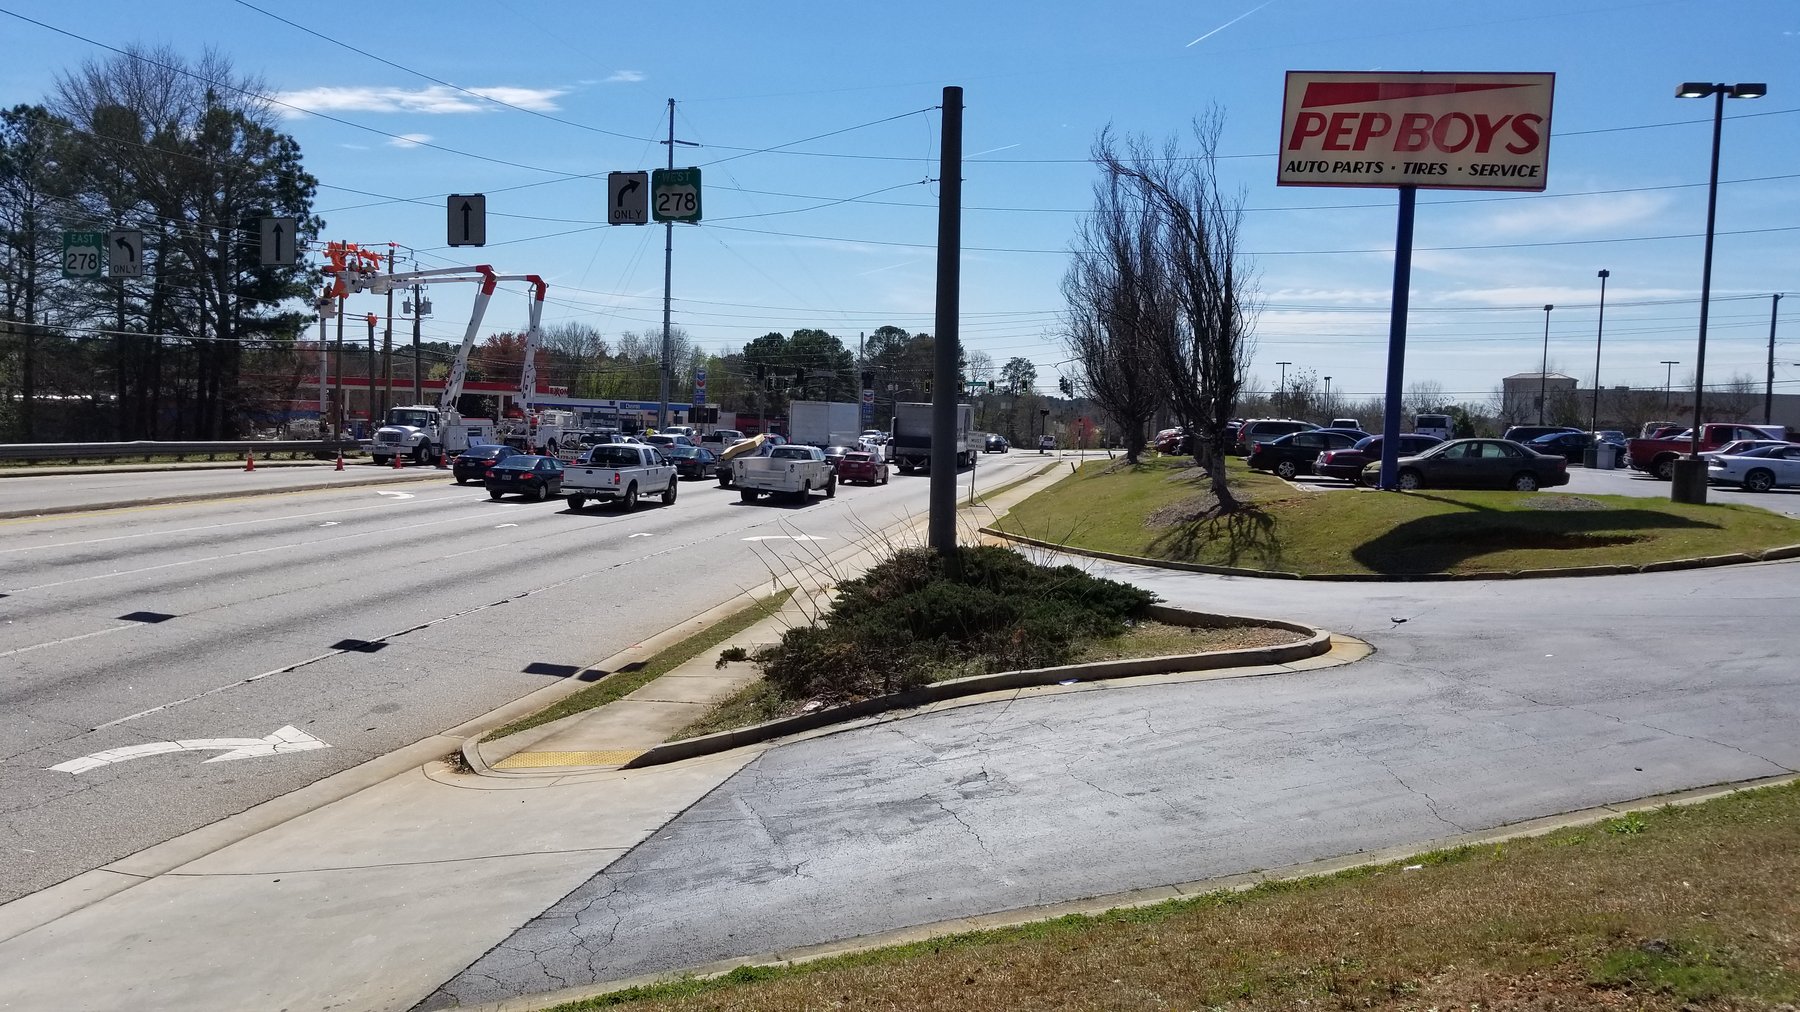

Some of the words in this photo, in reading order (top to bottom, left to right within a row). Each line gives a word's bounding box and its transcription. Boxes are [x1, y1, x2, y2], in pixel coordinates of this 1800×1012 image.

[1288, 111, 1392, 150] PEP
[1392, 111, 1544, 155] BOYS
[1285, 160, 1329, 173] AUTO
[1332, 161, 1384, 174] PARTS
[1403, 162, 1448, 176] TIRES
[1469, 163, 1541, 178] SERVICE
[662, 172, 690, 182] WEST
[658, 192, 696, 211] 278
[614, 210, 642, 219] ONLY
[71, 234, 94, 243] EAST
[67, 253, 97, 270] 278
[113, 265, 137, 274] ONLY
